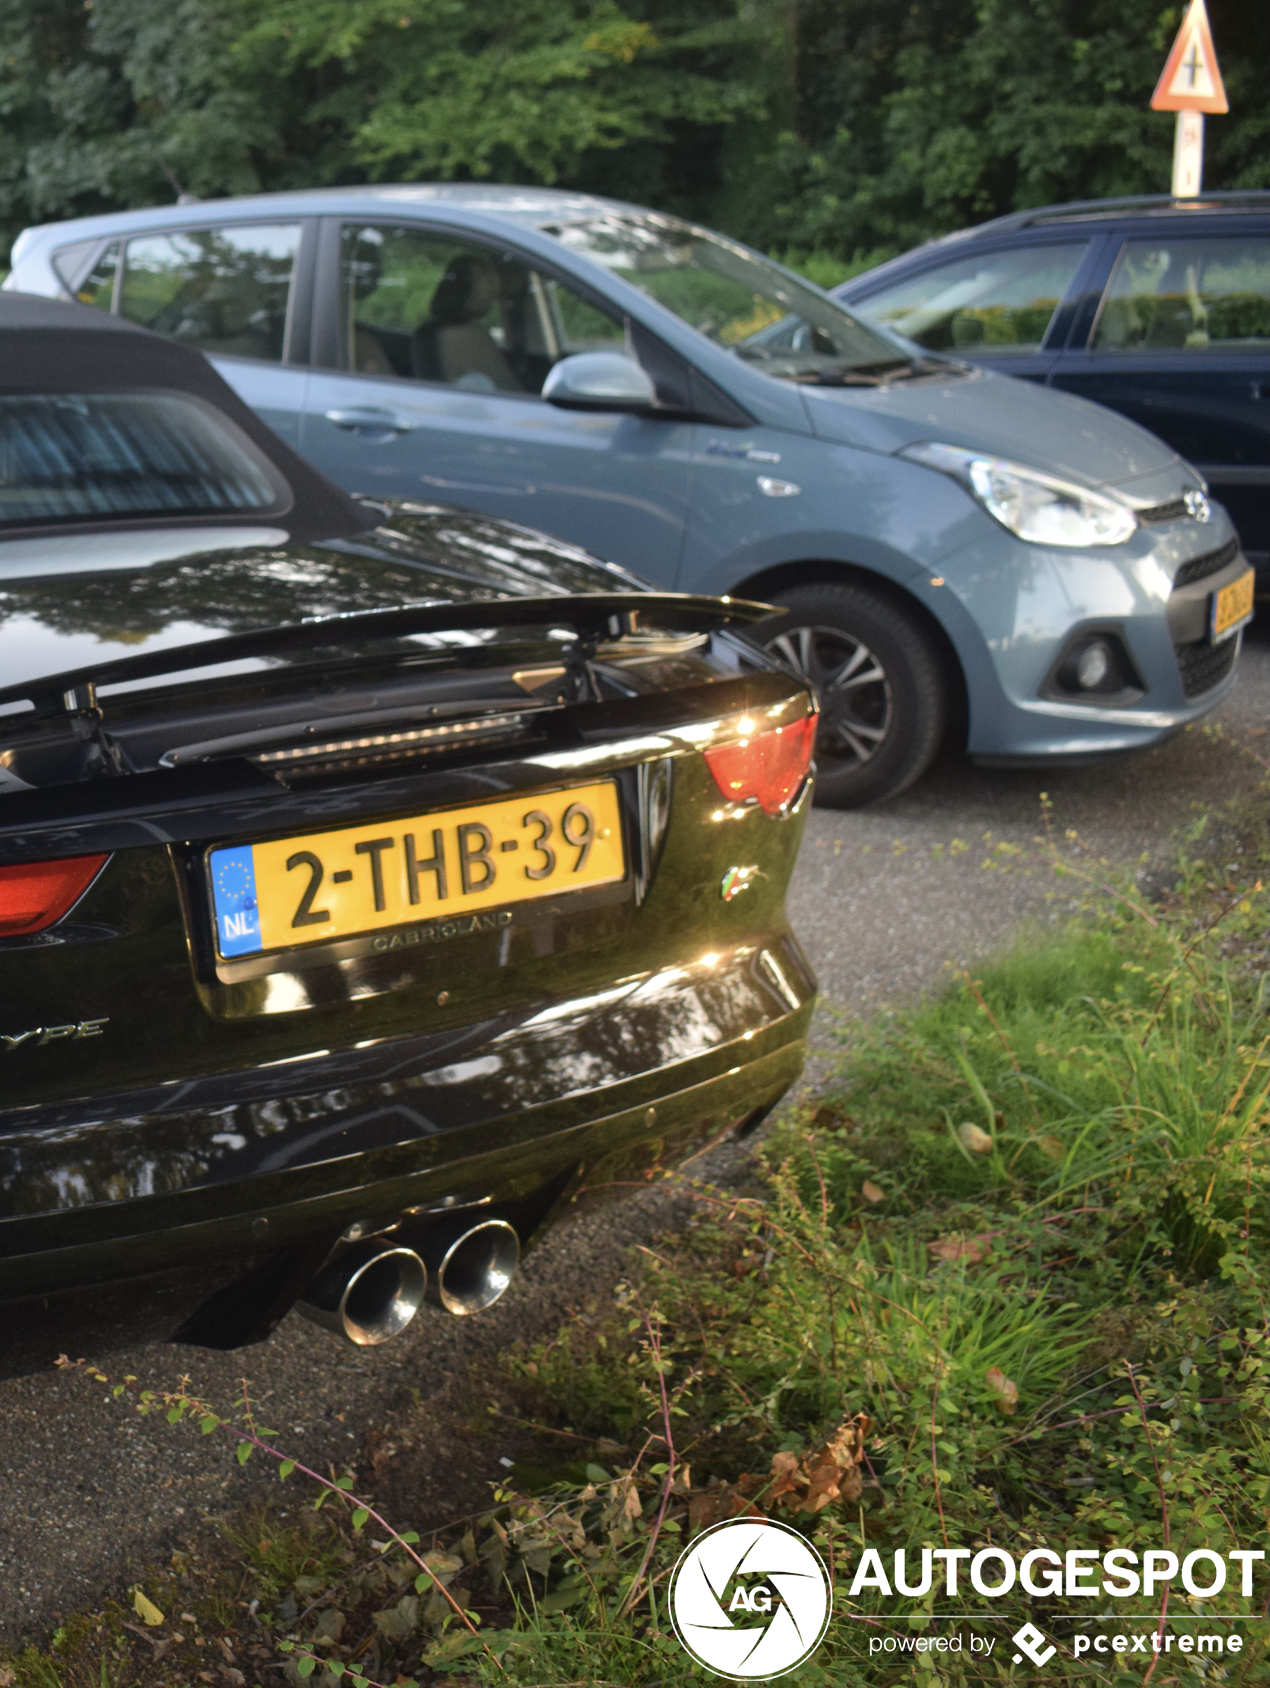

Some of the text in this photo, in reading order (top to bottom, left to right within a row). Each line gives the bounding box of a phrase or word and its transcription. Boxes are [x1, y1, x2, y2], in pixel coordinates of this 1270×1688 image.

[285, 802, 596, 928] 2-THB-39
[223, 912, 255, 940] NL
[372, 911, 513, 951] CABRIOLAND
